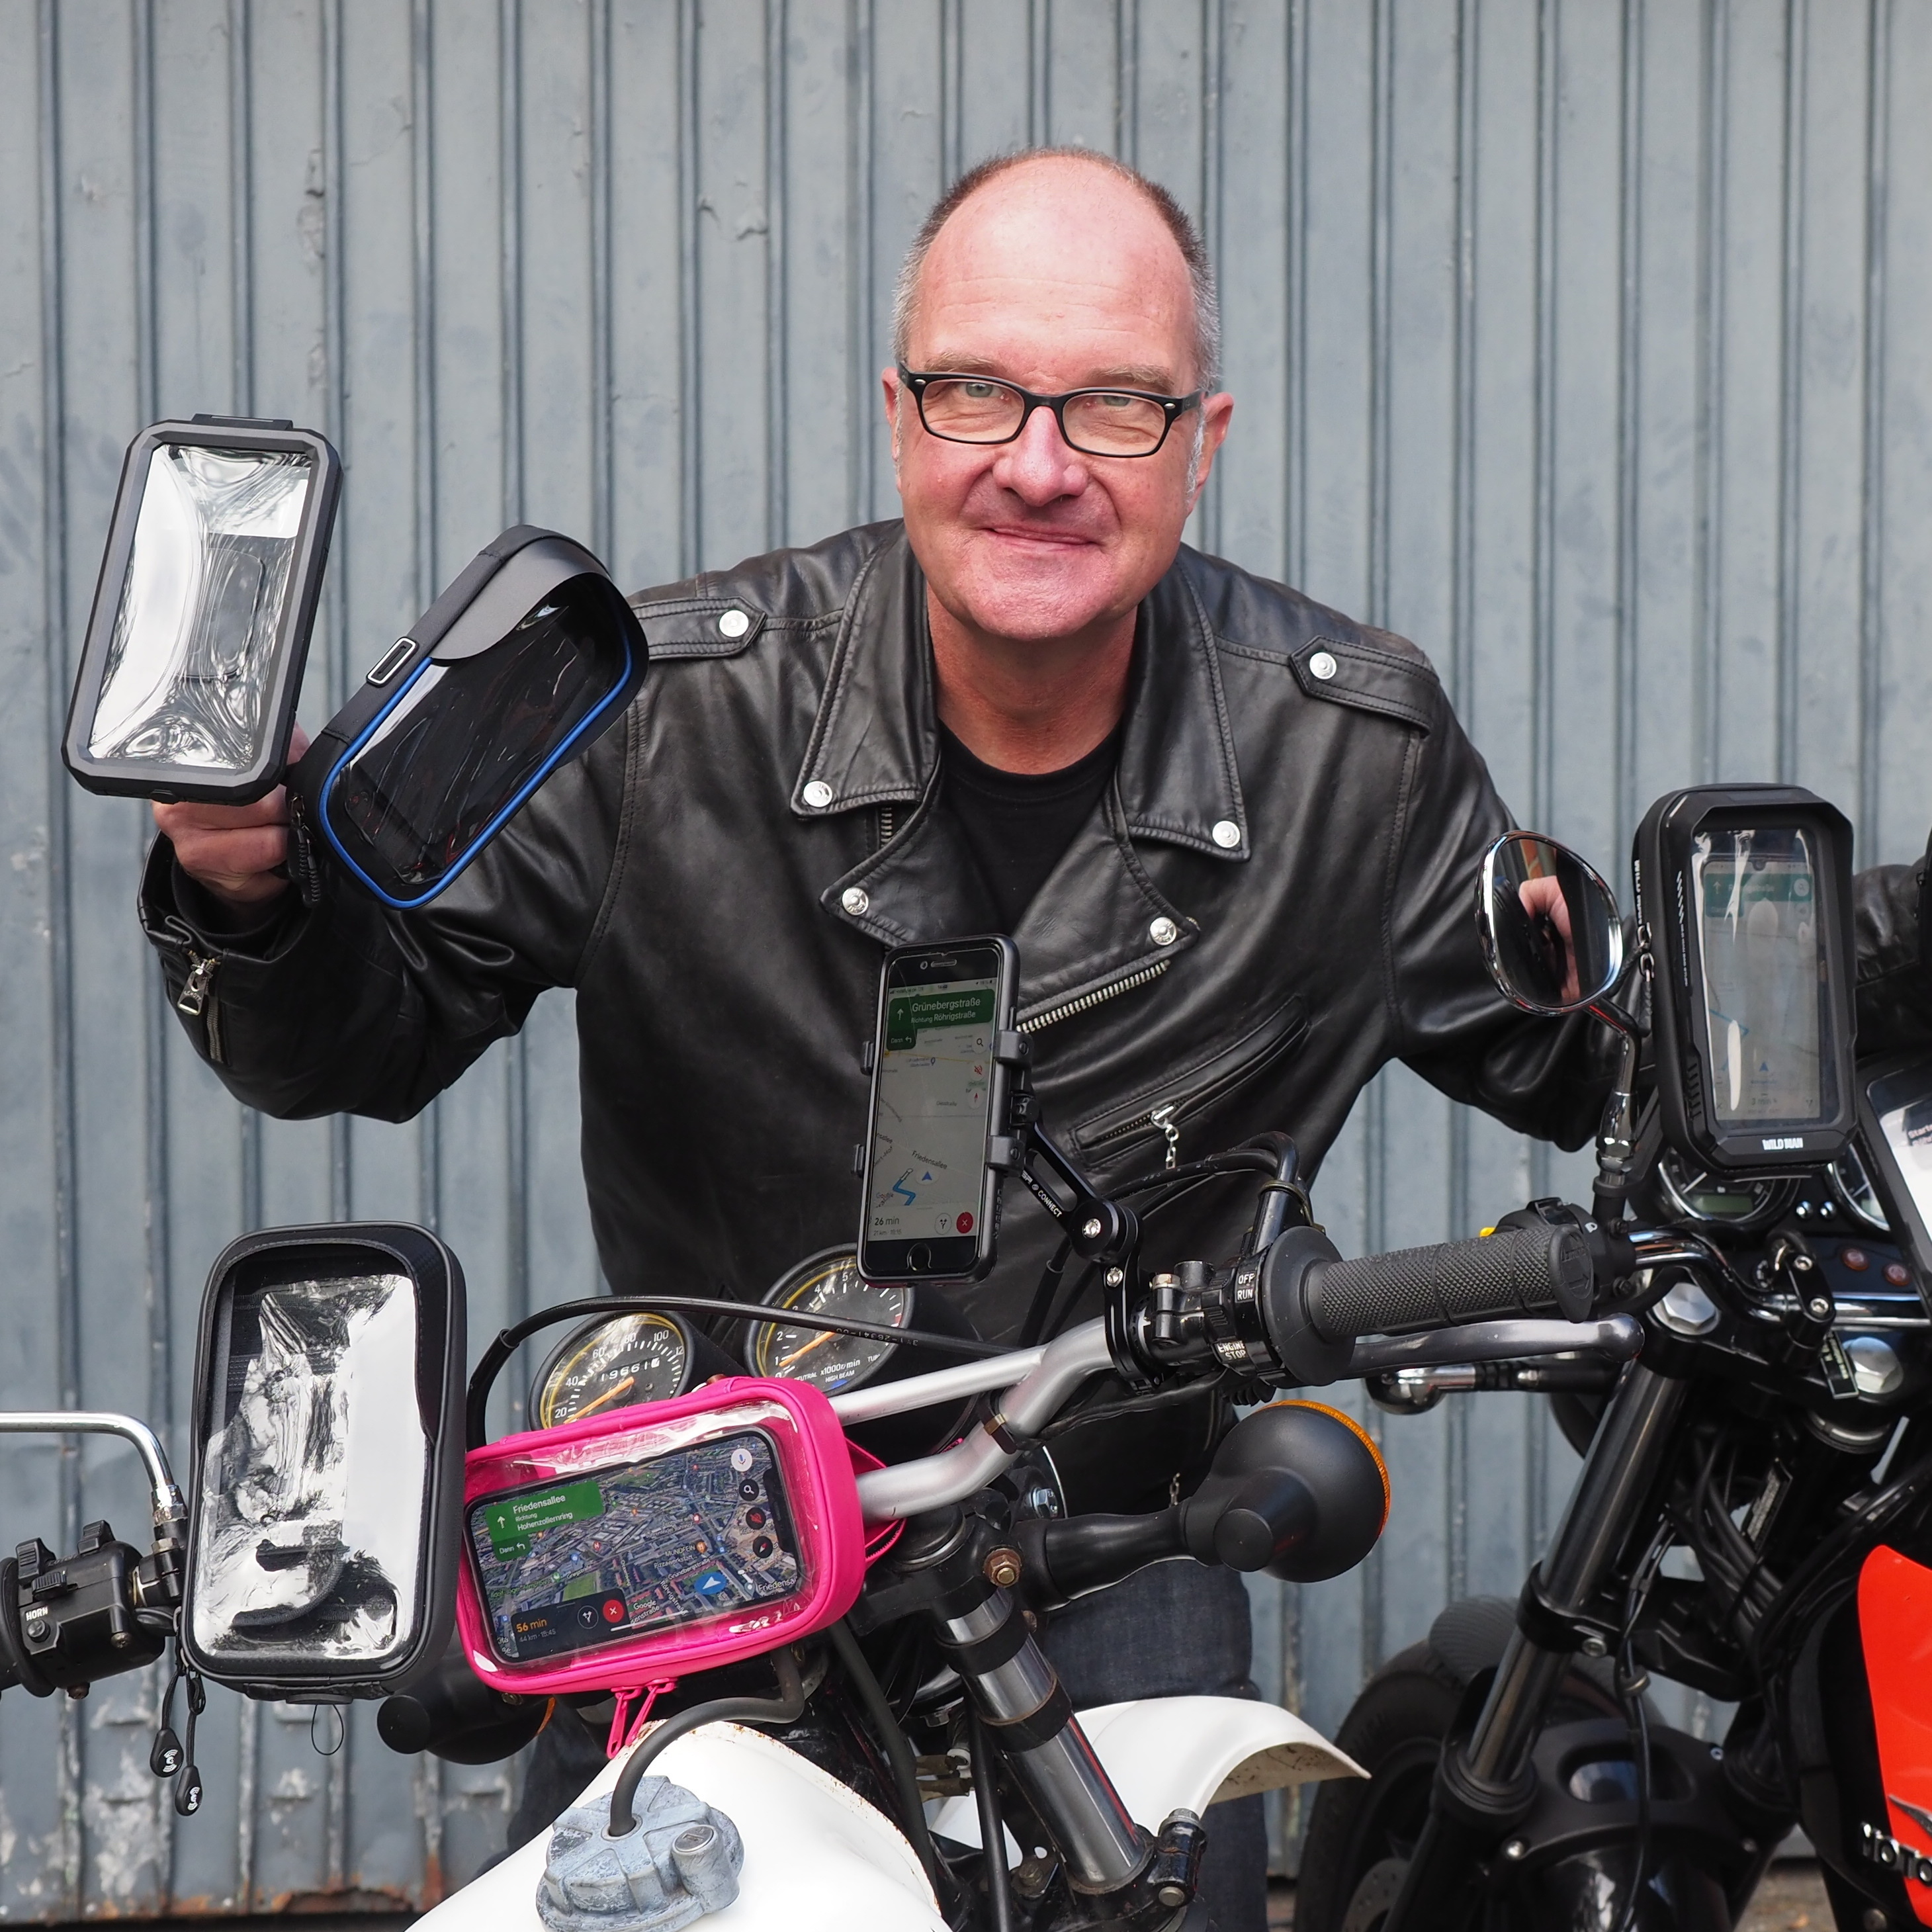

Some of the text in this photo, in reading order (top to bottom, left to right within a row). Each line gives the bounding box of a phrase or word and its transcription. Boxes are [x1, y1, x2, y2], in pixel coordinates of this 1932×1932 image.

[912, 997, 981, 1012] Grünebergstraße
[934, 1010, 976, 1022] Röhrigstraße
[1037, 1190, 1063, 1218] CONNECT
[885, 1216, 900, 1225] min
[1238, 1272, 1255, 1284] OFF
[814, 1284, 821, 1294] 4
[1237, 1288, 1253, 1301] RUN
[625, 1333, 637, 1343] 80
[653, 1330, 669, 1342] 100
[776, 1331, 783, 1341] 2
[1217, 1340, 1245, 1353] ENGINE
[593, 1347, 605, 1358] 60
[1225, 1350, 1246, 1360] STOP
[775, 1356, 779, 1366] 1
[566, 1376, 579, 1387] 40
[825, 1370, 855, 1383] HIGH BEAM
[554, 1407, 567, 1418] 20
[513, 1495, 566, 1515] Friedensallee
[515, 1513, 537, 1522] Richtung
[517, 1511, 573, 1531] Hohenzollernring
[499, 1546, 514, 1554] Dann
[633, 1599, 656, 1610] Google
[26, 1606, 48, 1621] HORN
[515, 1618, 547, 1633] 56 min
